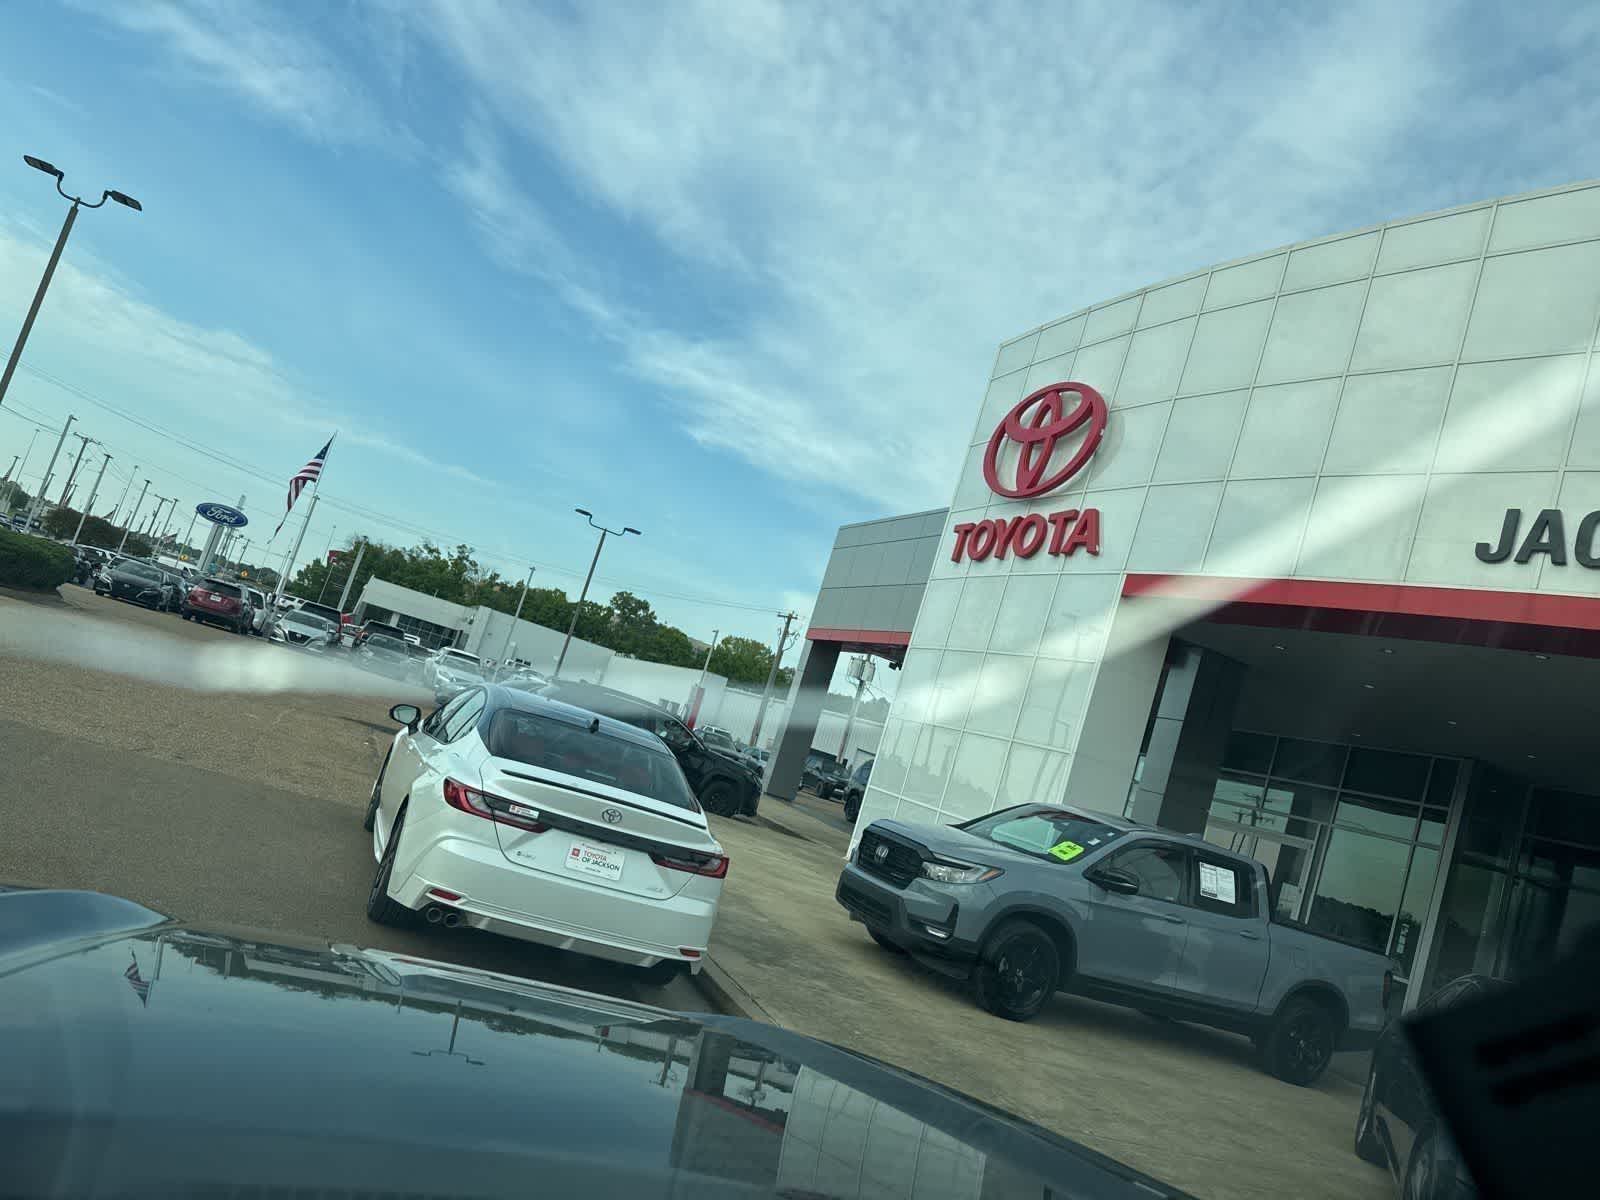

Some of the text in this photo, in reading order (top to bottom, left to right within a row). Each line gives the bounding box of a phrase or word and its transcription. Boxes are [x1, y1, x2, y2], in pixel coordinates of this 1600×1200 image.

[207, 507, 237, 523] Ford
[952, 508, 1100, 563] TOYOTA
[581, 856, 592, 864] OF
[591, 859, 620, 872] JACKSON
[583, 850, 608, 862] TOYOTA
